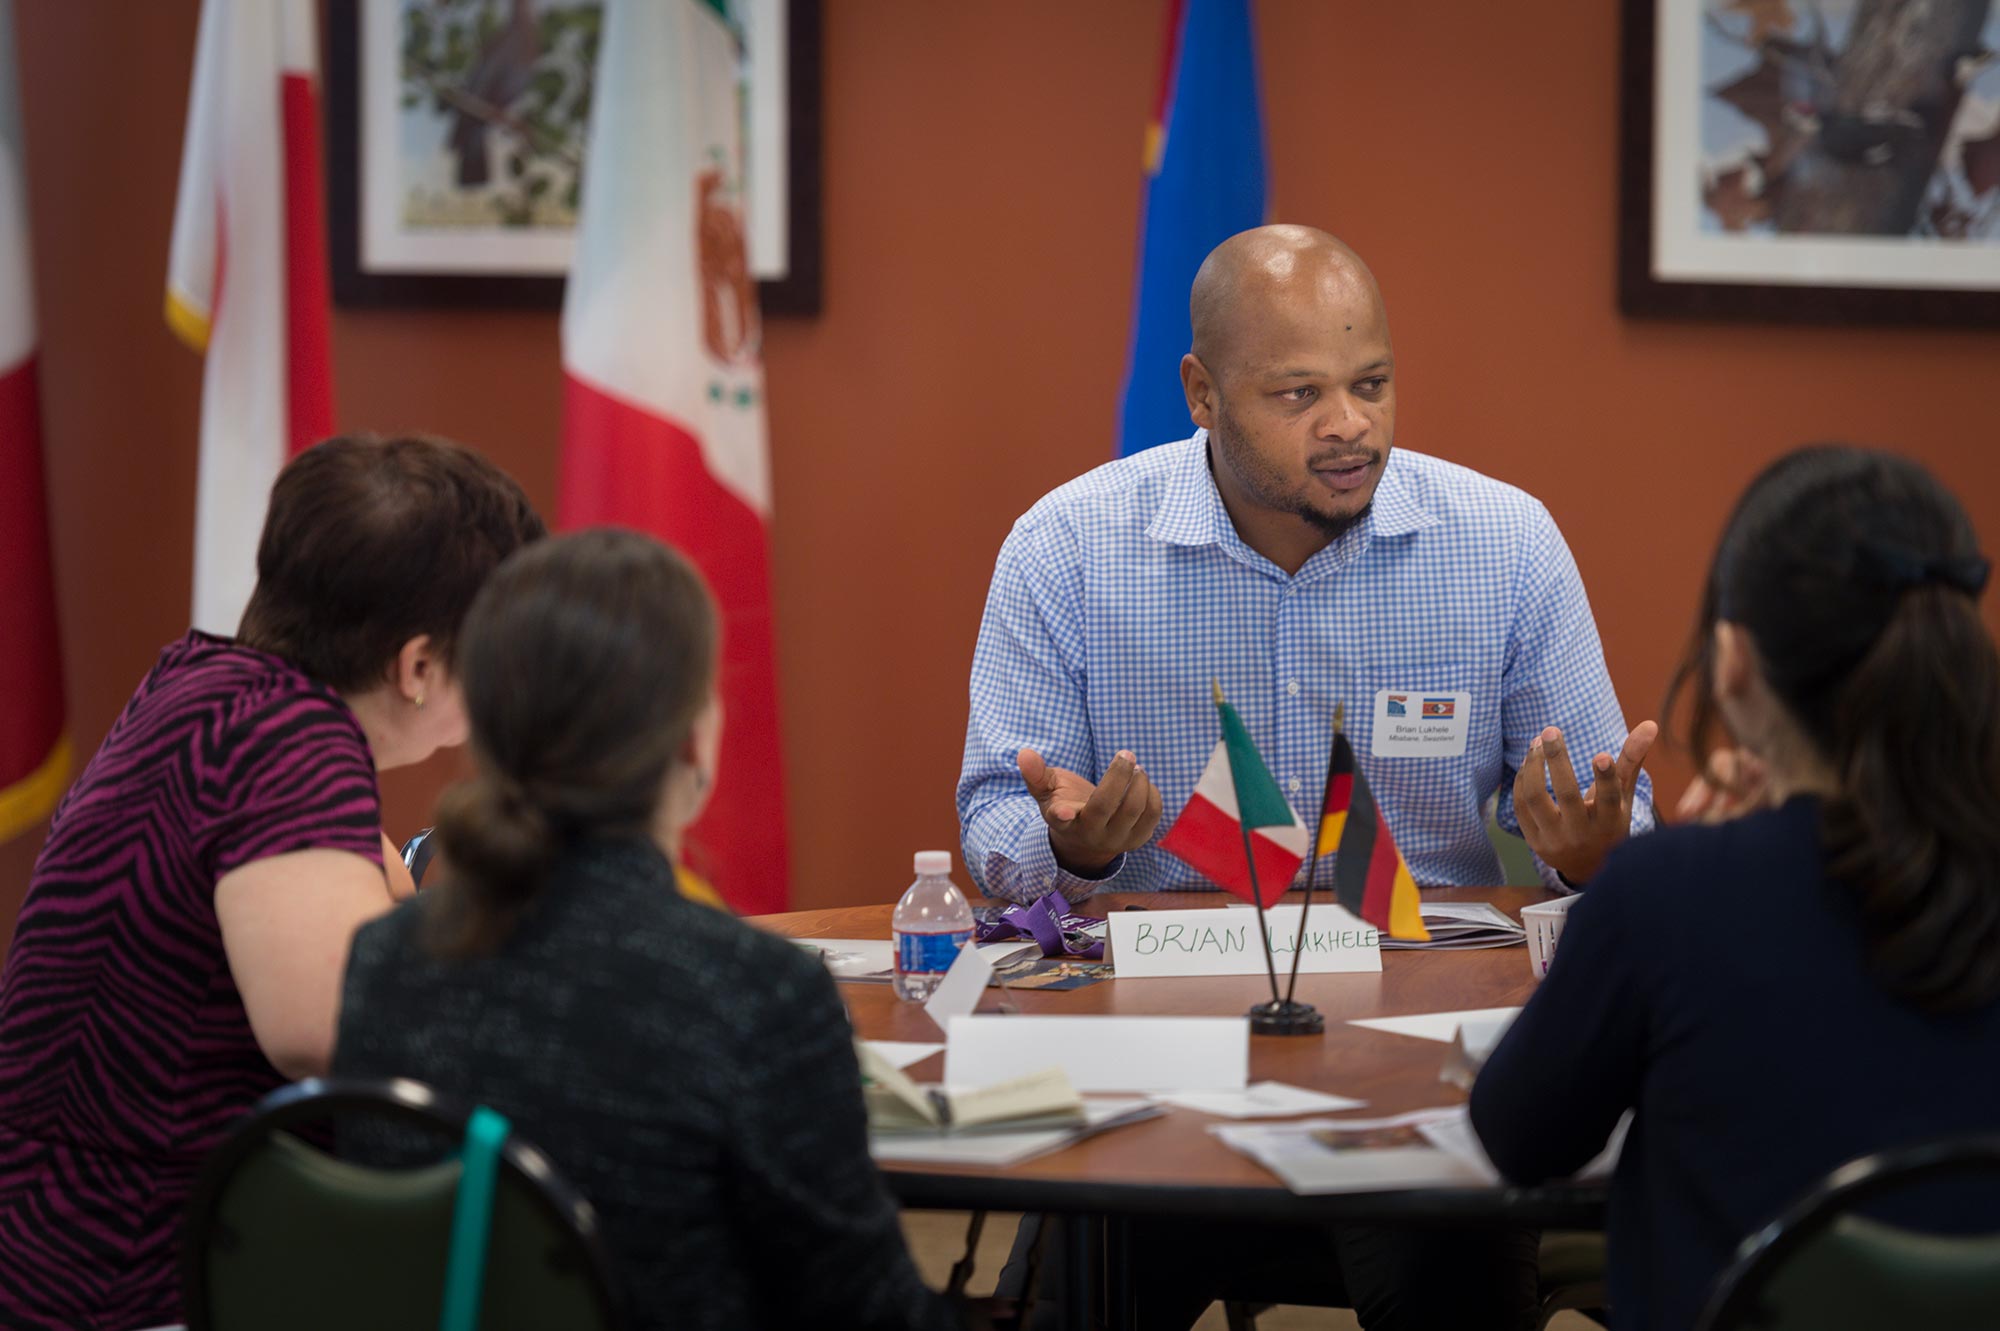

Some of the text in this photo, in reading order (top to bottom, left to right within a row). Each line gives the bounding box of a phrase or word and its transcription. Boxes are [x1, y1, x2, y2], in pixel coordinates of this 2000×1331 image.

[1395, 725, 1449, 733] Brian Lukhele
[1135, 923, 1380, 954] BRIAN LUKHELE
